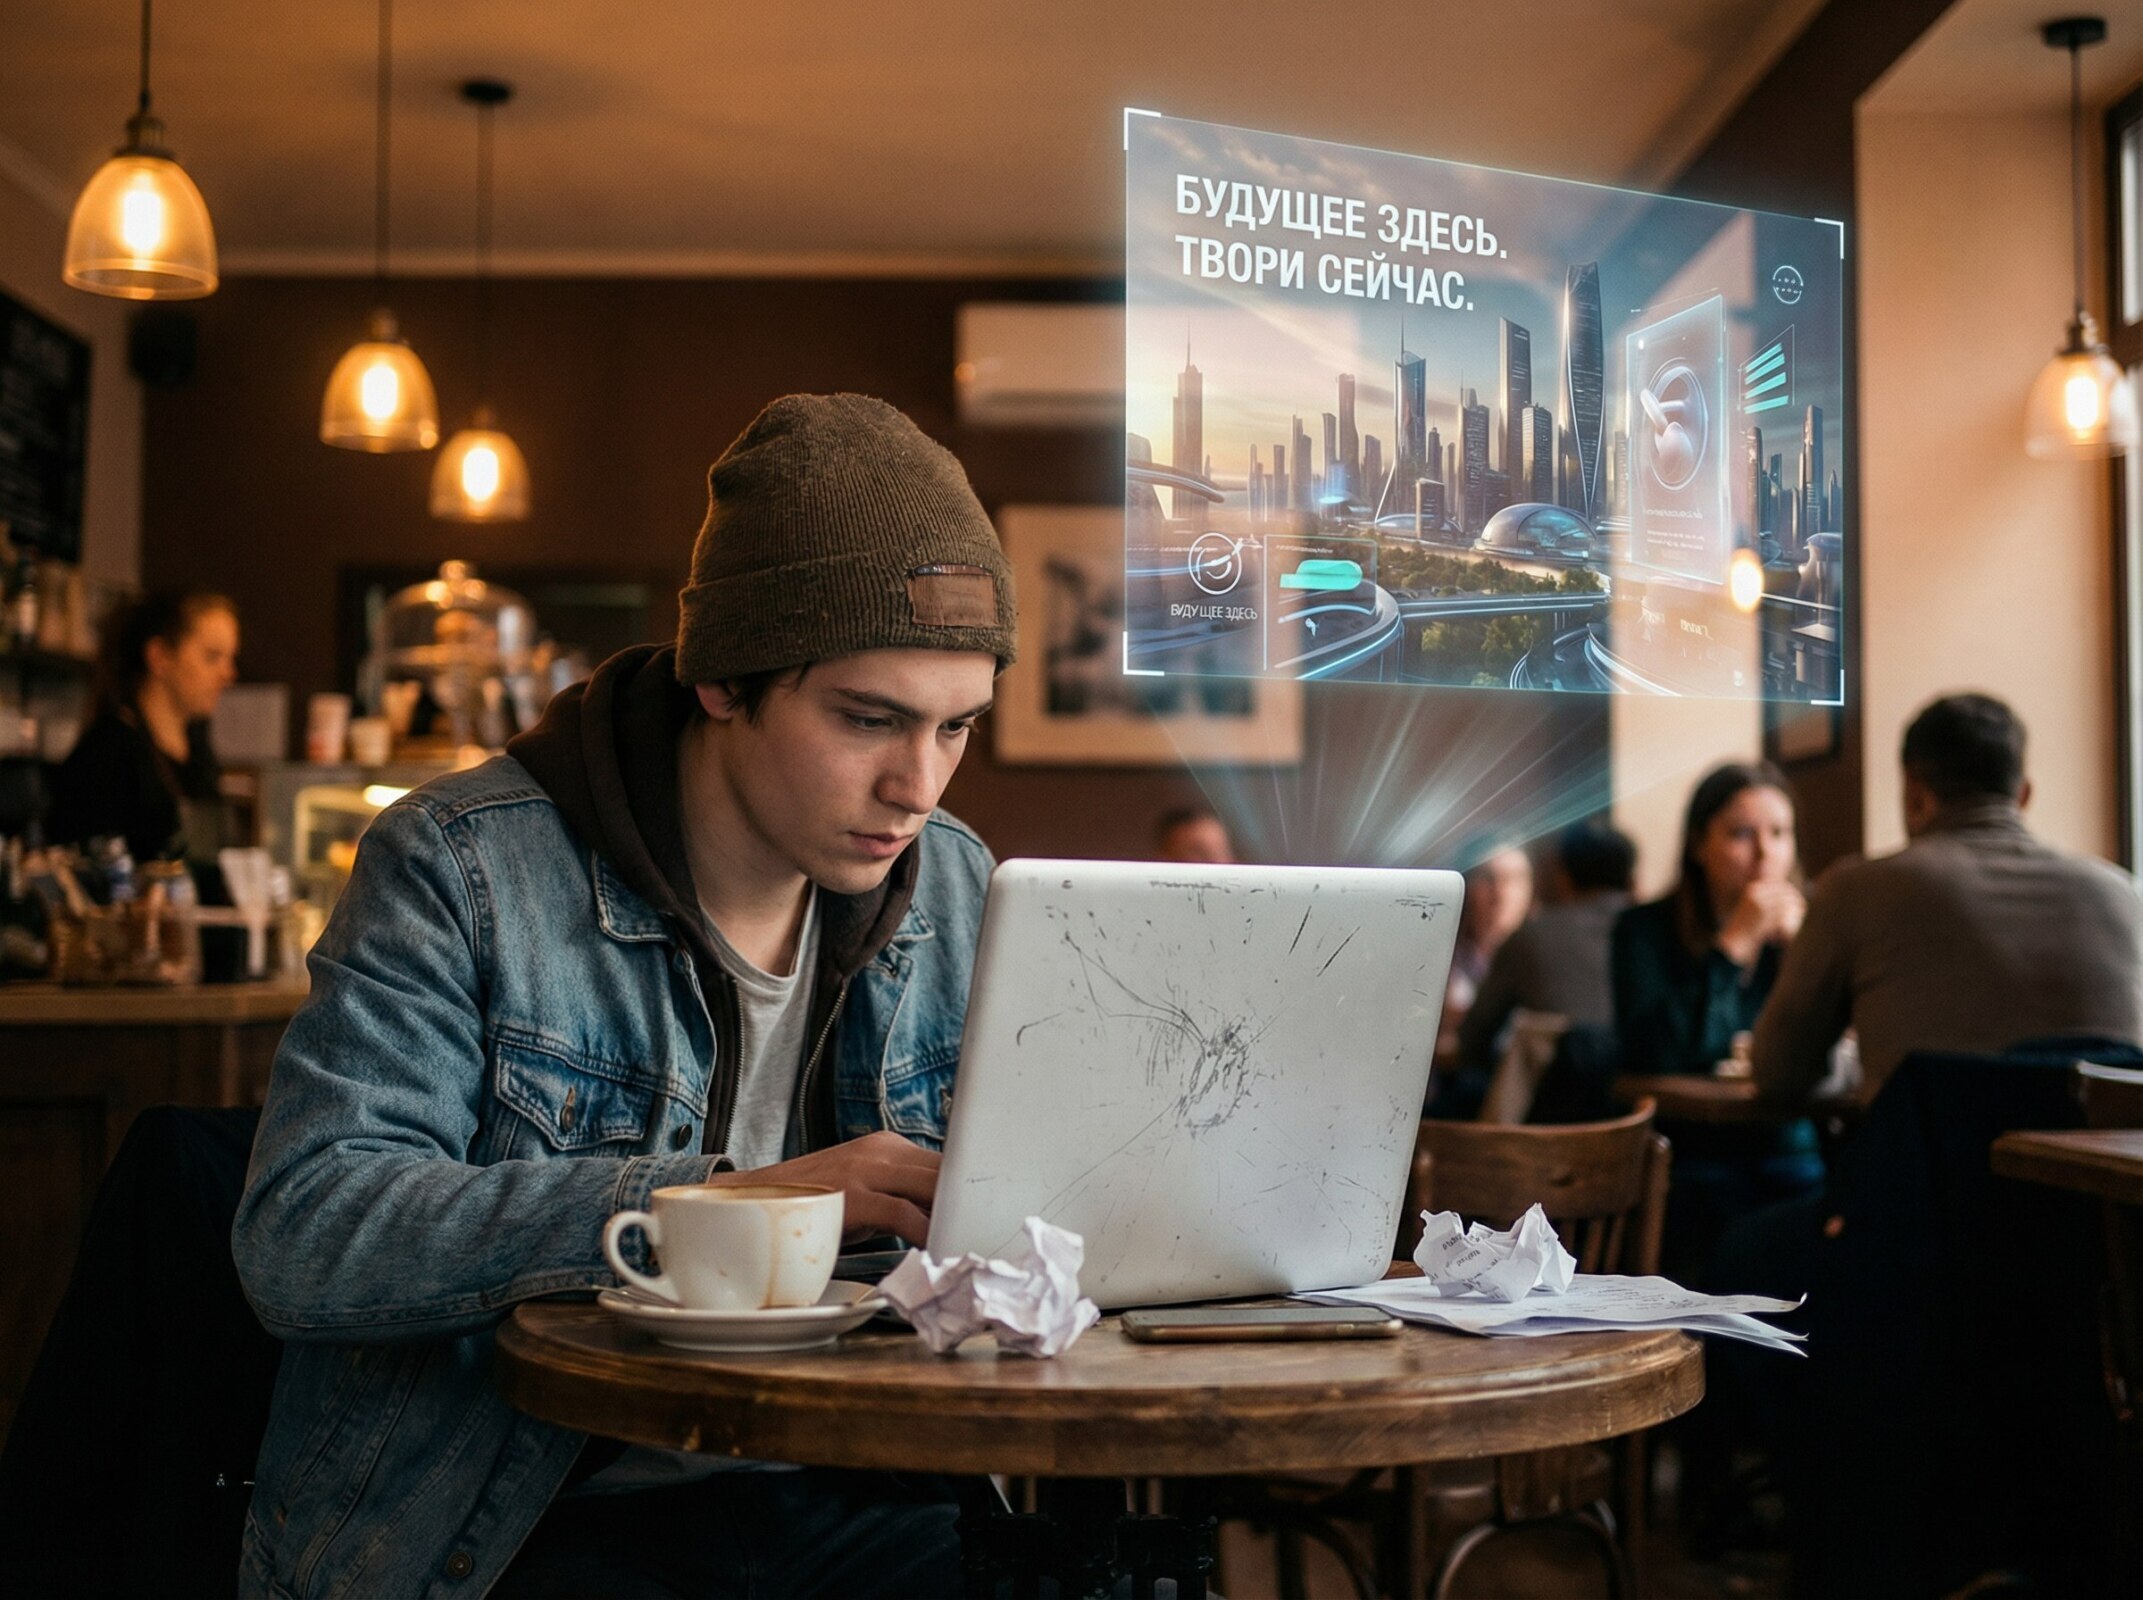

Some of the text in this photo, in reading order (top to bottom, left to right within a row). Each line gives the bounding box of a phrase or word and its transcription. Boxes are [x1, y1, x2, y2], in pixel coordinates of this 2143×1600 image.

[1176, 173, 1508, 259] БУДУЩЕЕ ЗДЕСЬ.
[1175, 234, 1474, 311] ТВОРИ СЕЙЧАС.
[1224, 606, 1258, 621] ЗДЕСЬ
